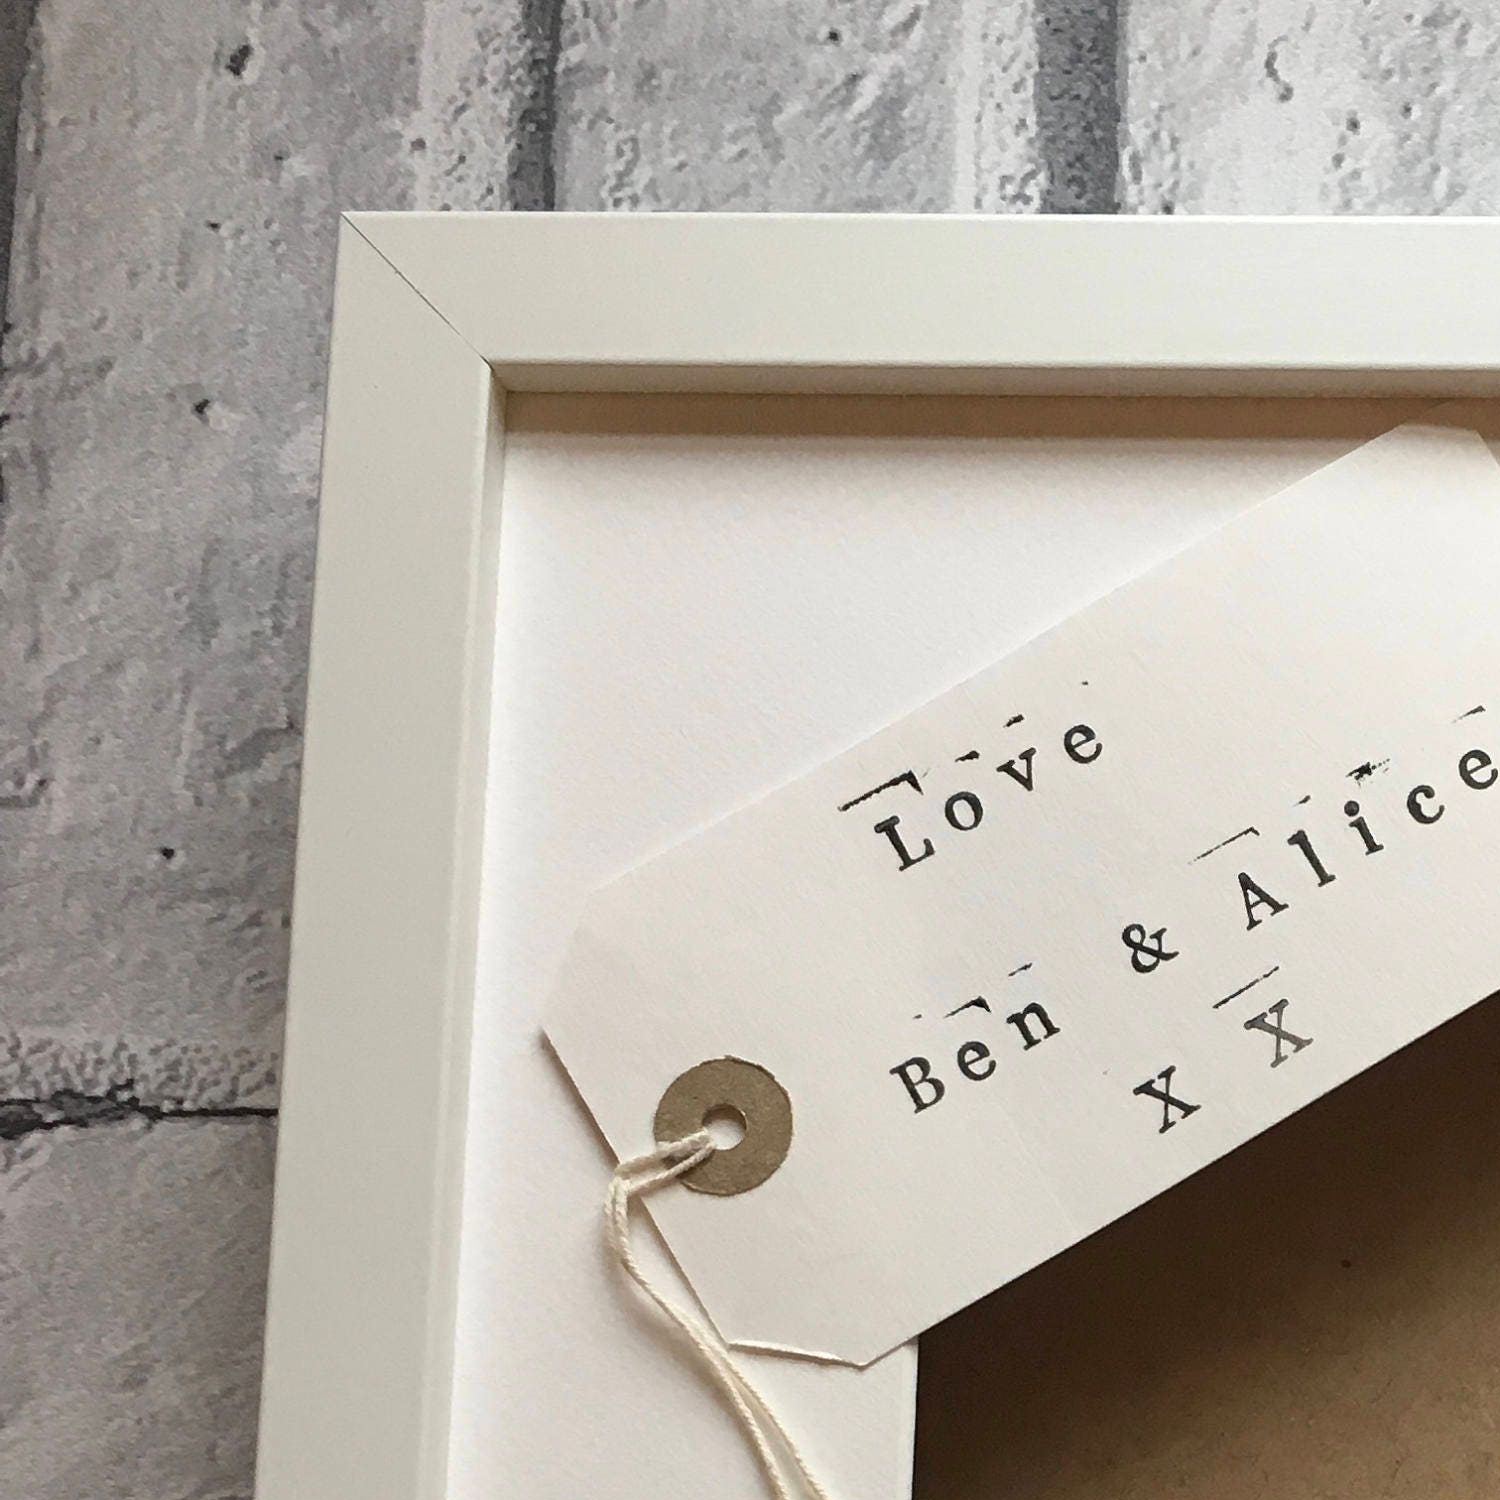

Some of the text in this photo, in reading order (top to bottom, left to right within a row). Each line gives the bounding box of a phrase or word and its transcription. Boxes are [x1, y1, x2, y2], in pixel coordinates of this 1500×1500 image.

[873, 723, 1104, 872] Love
[888, 748, 1499, 1114] Ben & Alice
